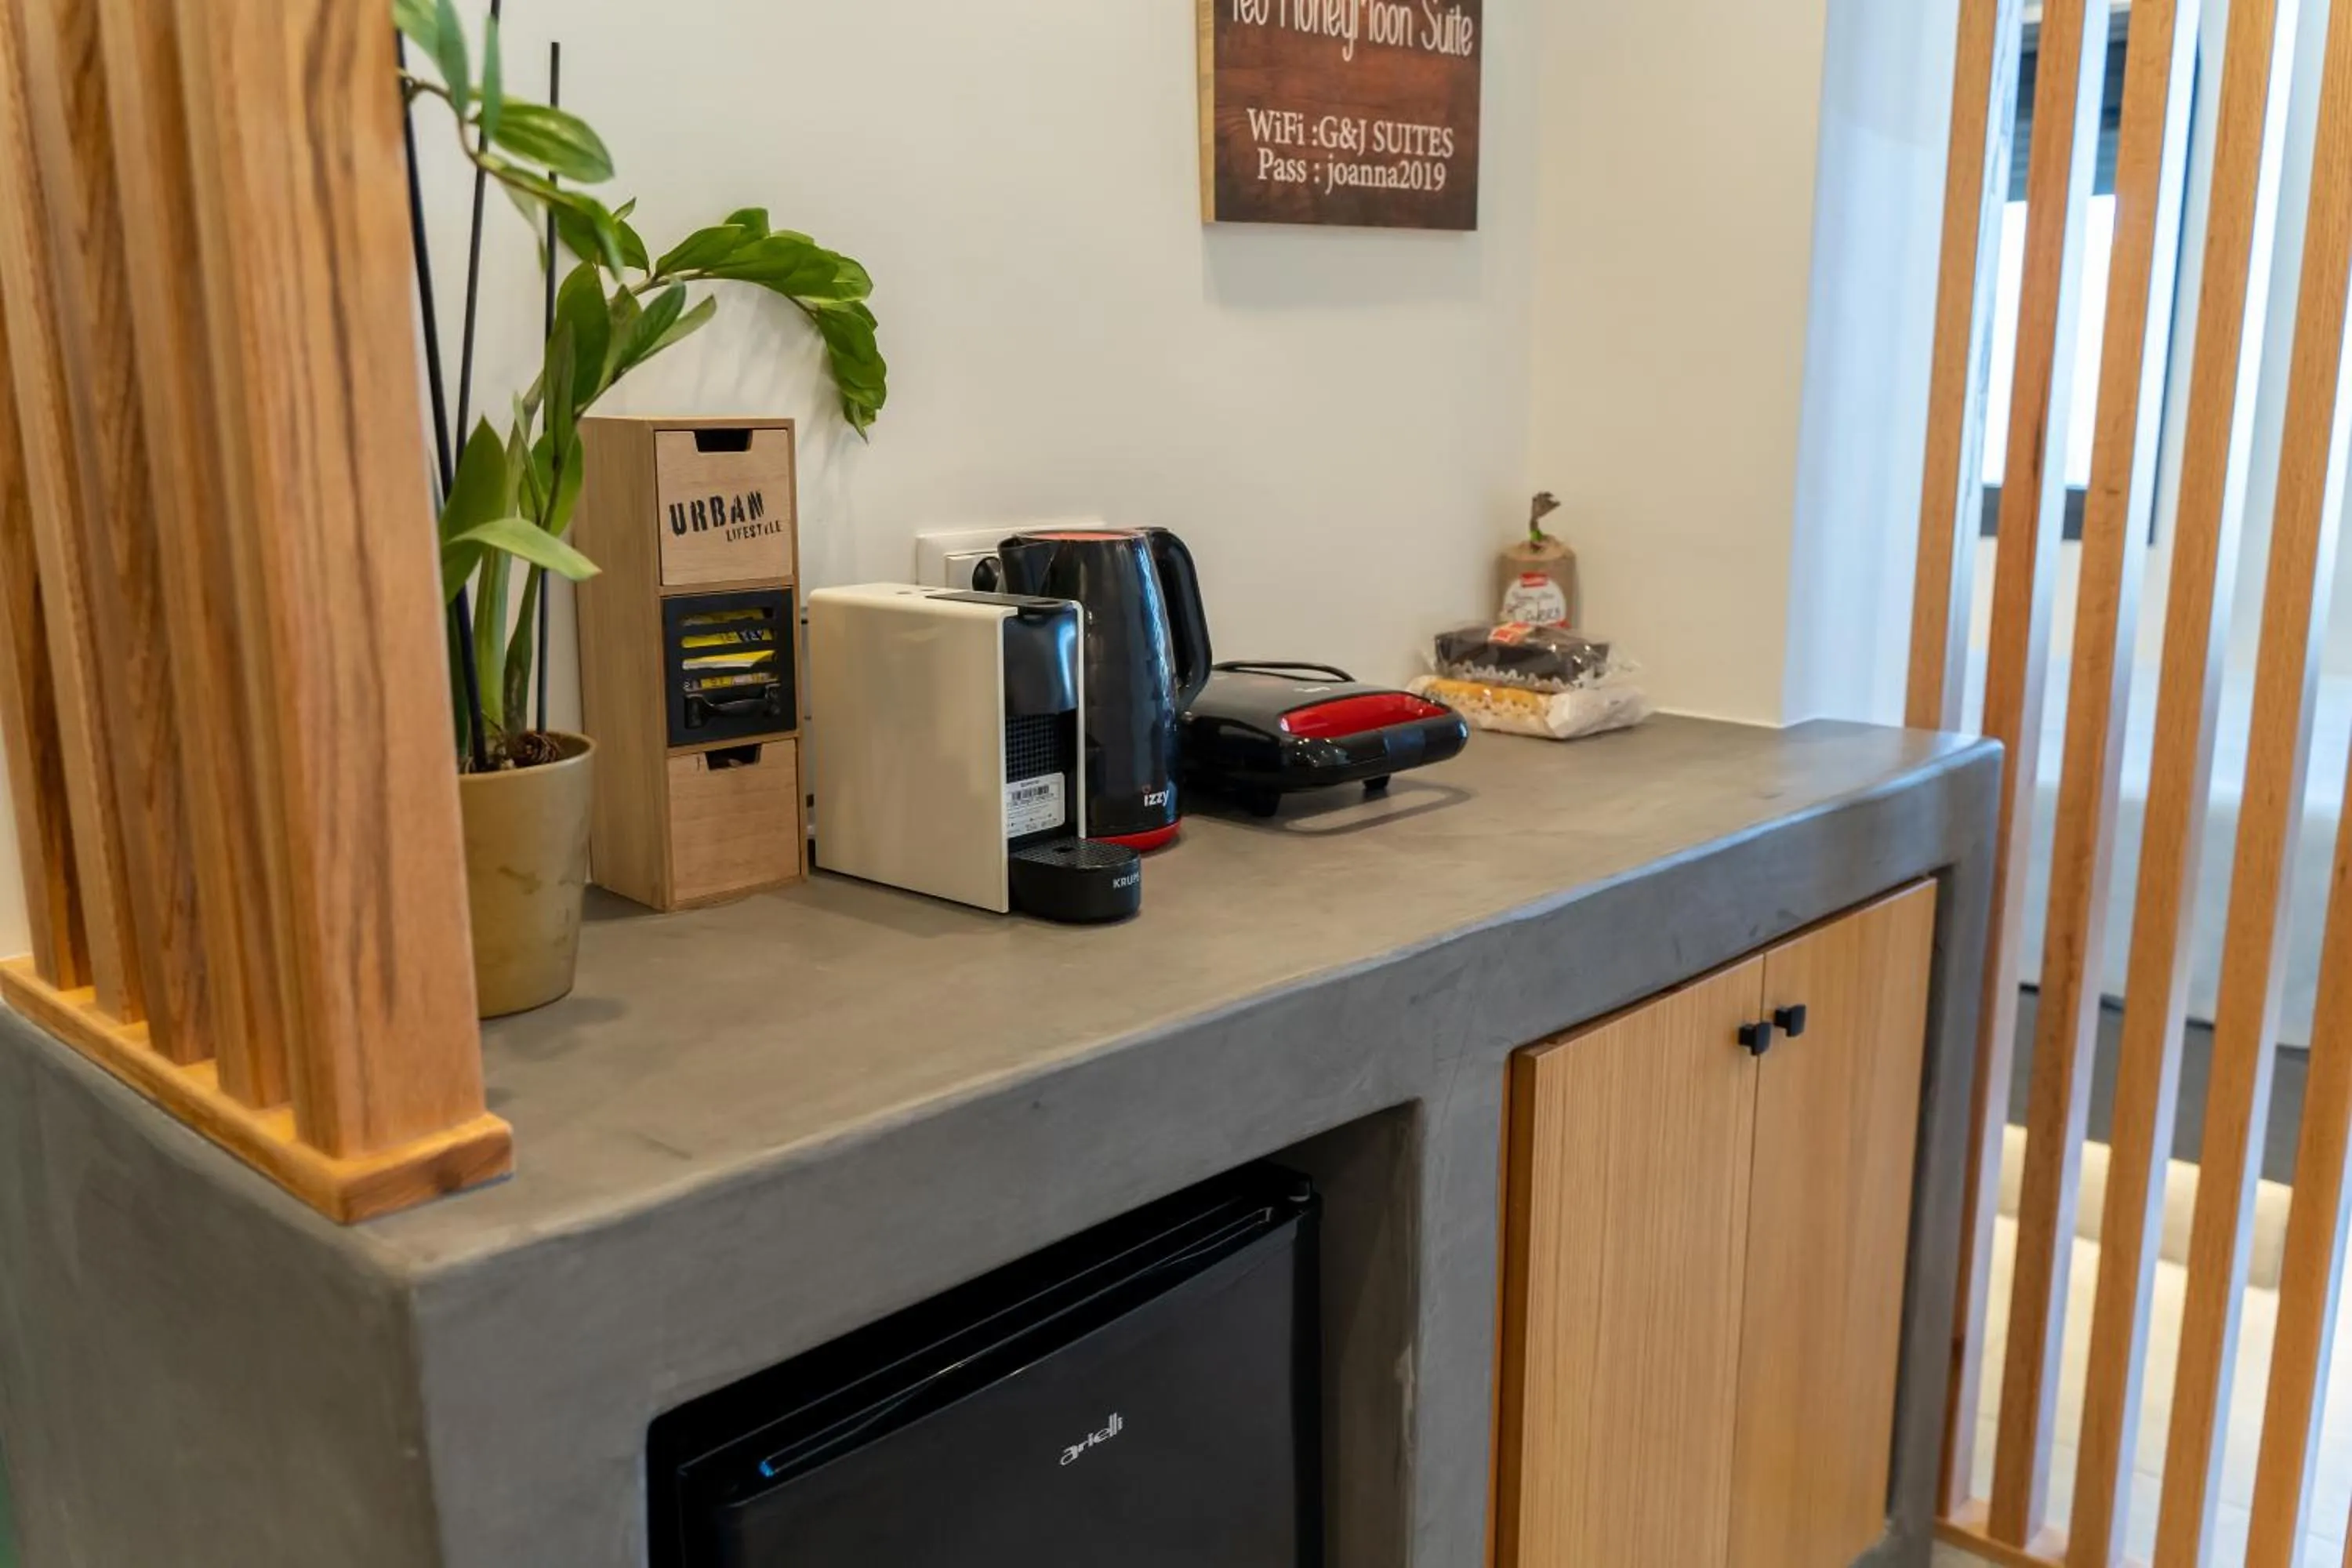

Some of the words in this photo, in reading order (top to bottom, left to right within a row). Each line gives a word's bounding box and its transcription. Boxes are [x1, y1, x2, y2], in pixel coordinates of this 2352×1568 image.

[1421, 0, 1473, 56] Suite
[1247, 108, 1305, 145] WiFi
[1372, 121, 1454, 158] SUITES
[1257, 147, 1306, 183] Pass
[1325, 154, 1446, 194] joanna2019
[669, 489, 764, 536] URBAN
[725, 521, 782, 543] LIFESTYLE
[1060, 1412, 1123, 1465] arielli
